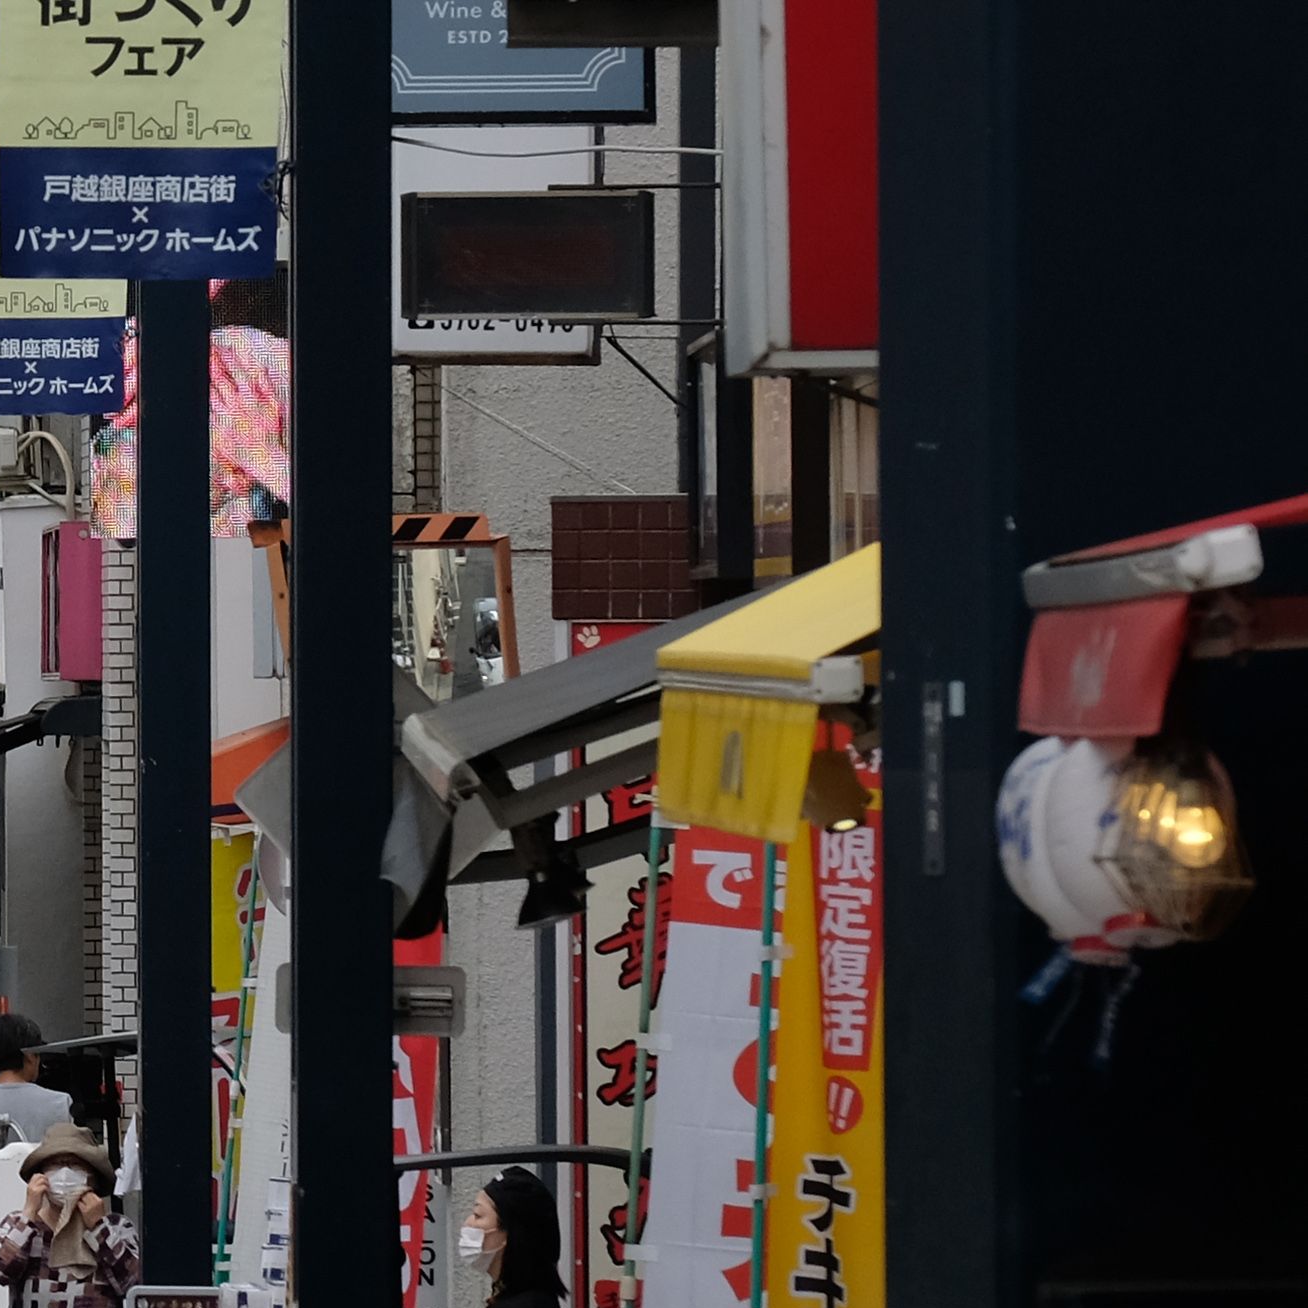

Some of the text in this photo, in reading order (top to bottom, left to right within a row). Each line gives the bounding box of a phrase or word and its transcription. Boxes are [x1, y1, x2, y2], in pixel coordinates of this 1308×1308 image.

[426, 0, 483, 18] Wine
[446, 29, 492, 45] ESTD
[86, 37, 204, 76] フェア
[44, 175, 235, 202] 戸越銀座商店街
[15, 226, 261, 252] パナソニック ホームズ
[50, 375, 114, 395] ホームズ
[690, 848, 755, 910] で
[819, 826, 876, 1056] 限定復活
